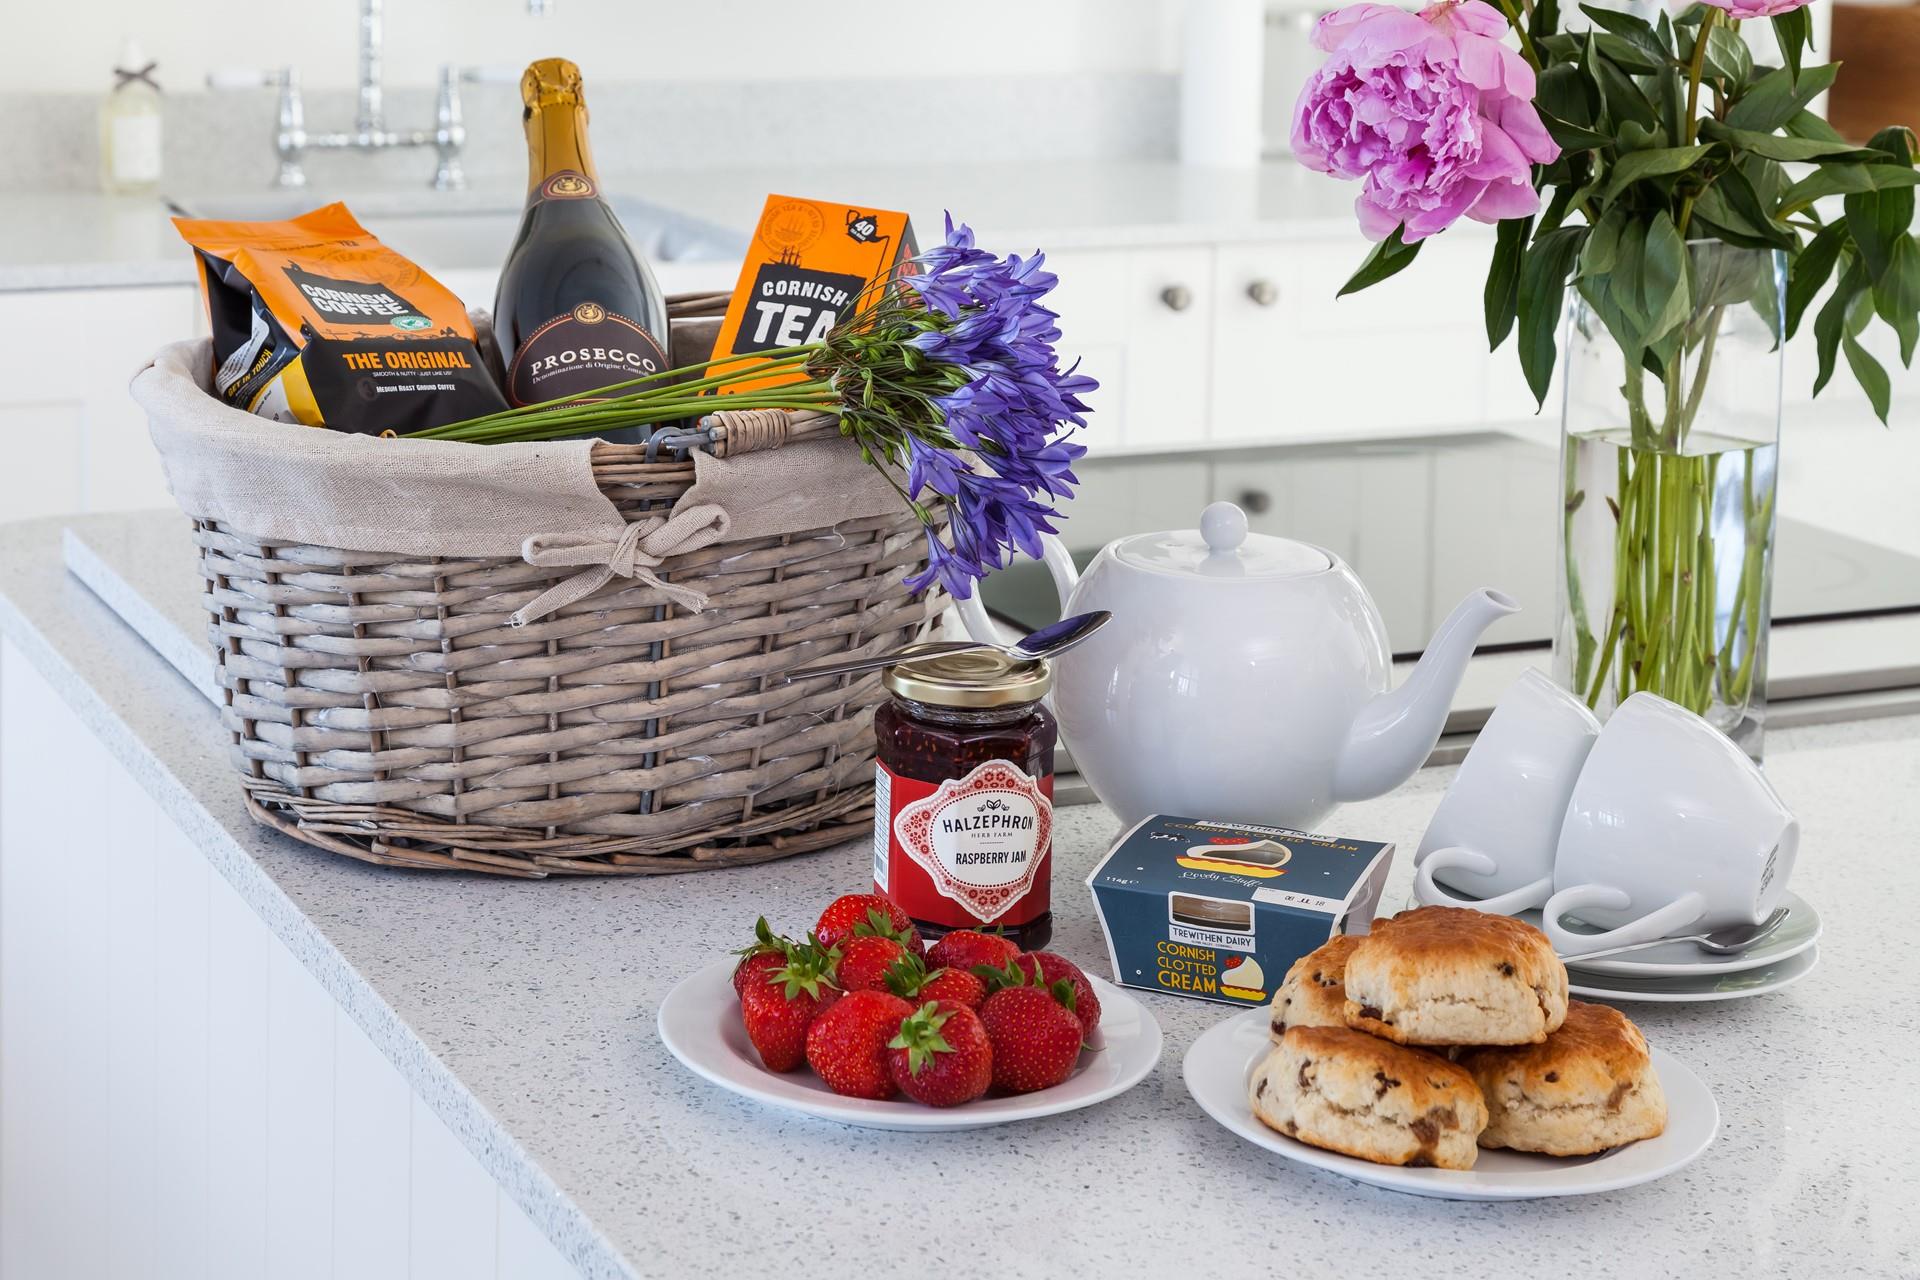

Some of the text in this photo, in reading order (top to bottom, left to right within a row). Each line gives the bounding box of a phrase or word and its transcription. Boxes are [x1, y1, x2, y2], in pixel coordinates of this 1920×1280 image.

[854, 220, 875, 236] 40
[301, 283, 395, 304] CORNISH
[762, 280, 848, 307] CORNISH
[312, 297, 409, 315] COFFEE
[753, 300, 836, 346] TEA
[342, 351, 472, 370] THE ORIGINAL
[531, 347, 657, 376] PROSECCO
[227, 349, 273, 397] GET IN TOUCH
[532, 362, 584, 384] Denominazione
[585, 361, 593, 369] di
[594, 361, 621, 371] Origine
[376, 385, 398, 393] MEDIUM
[398, 384, 415, 392] ROAST
[437, 383, 456, 391] COFFEE
[942, 814, 1034, 833] HALZEPHRON
[1164, 822, 1360, 851] CORNISH CLOTTED CREAM
[955, 850, 1027, 865] RASPBERRY JAM
[1178, 871, 1219, 881] Lovely
[1172, 927, 1225, 944] TREWITHEN
[1226, 936, 1252, 947] DAIRY
[1157, 941, 1216, 962] CORNISH
[1157, 956, 1217, 976] CLOTTED
[1157, 970, 1217, 994] CREAM
